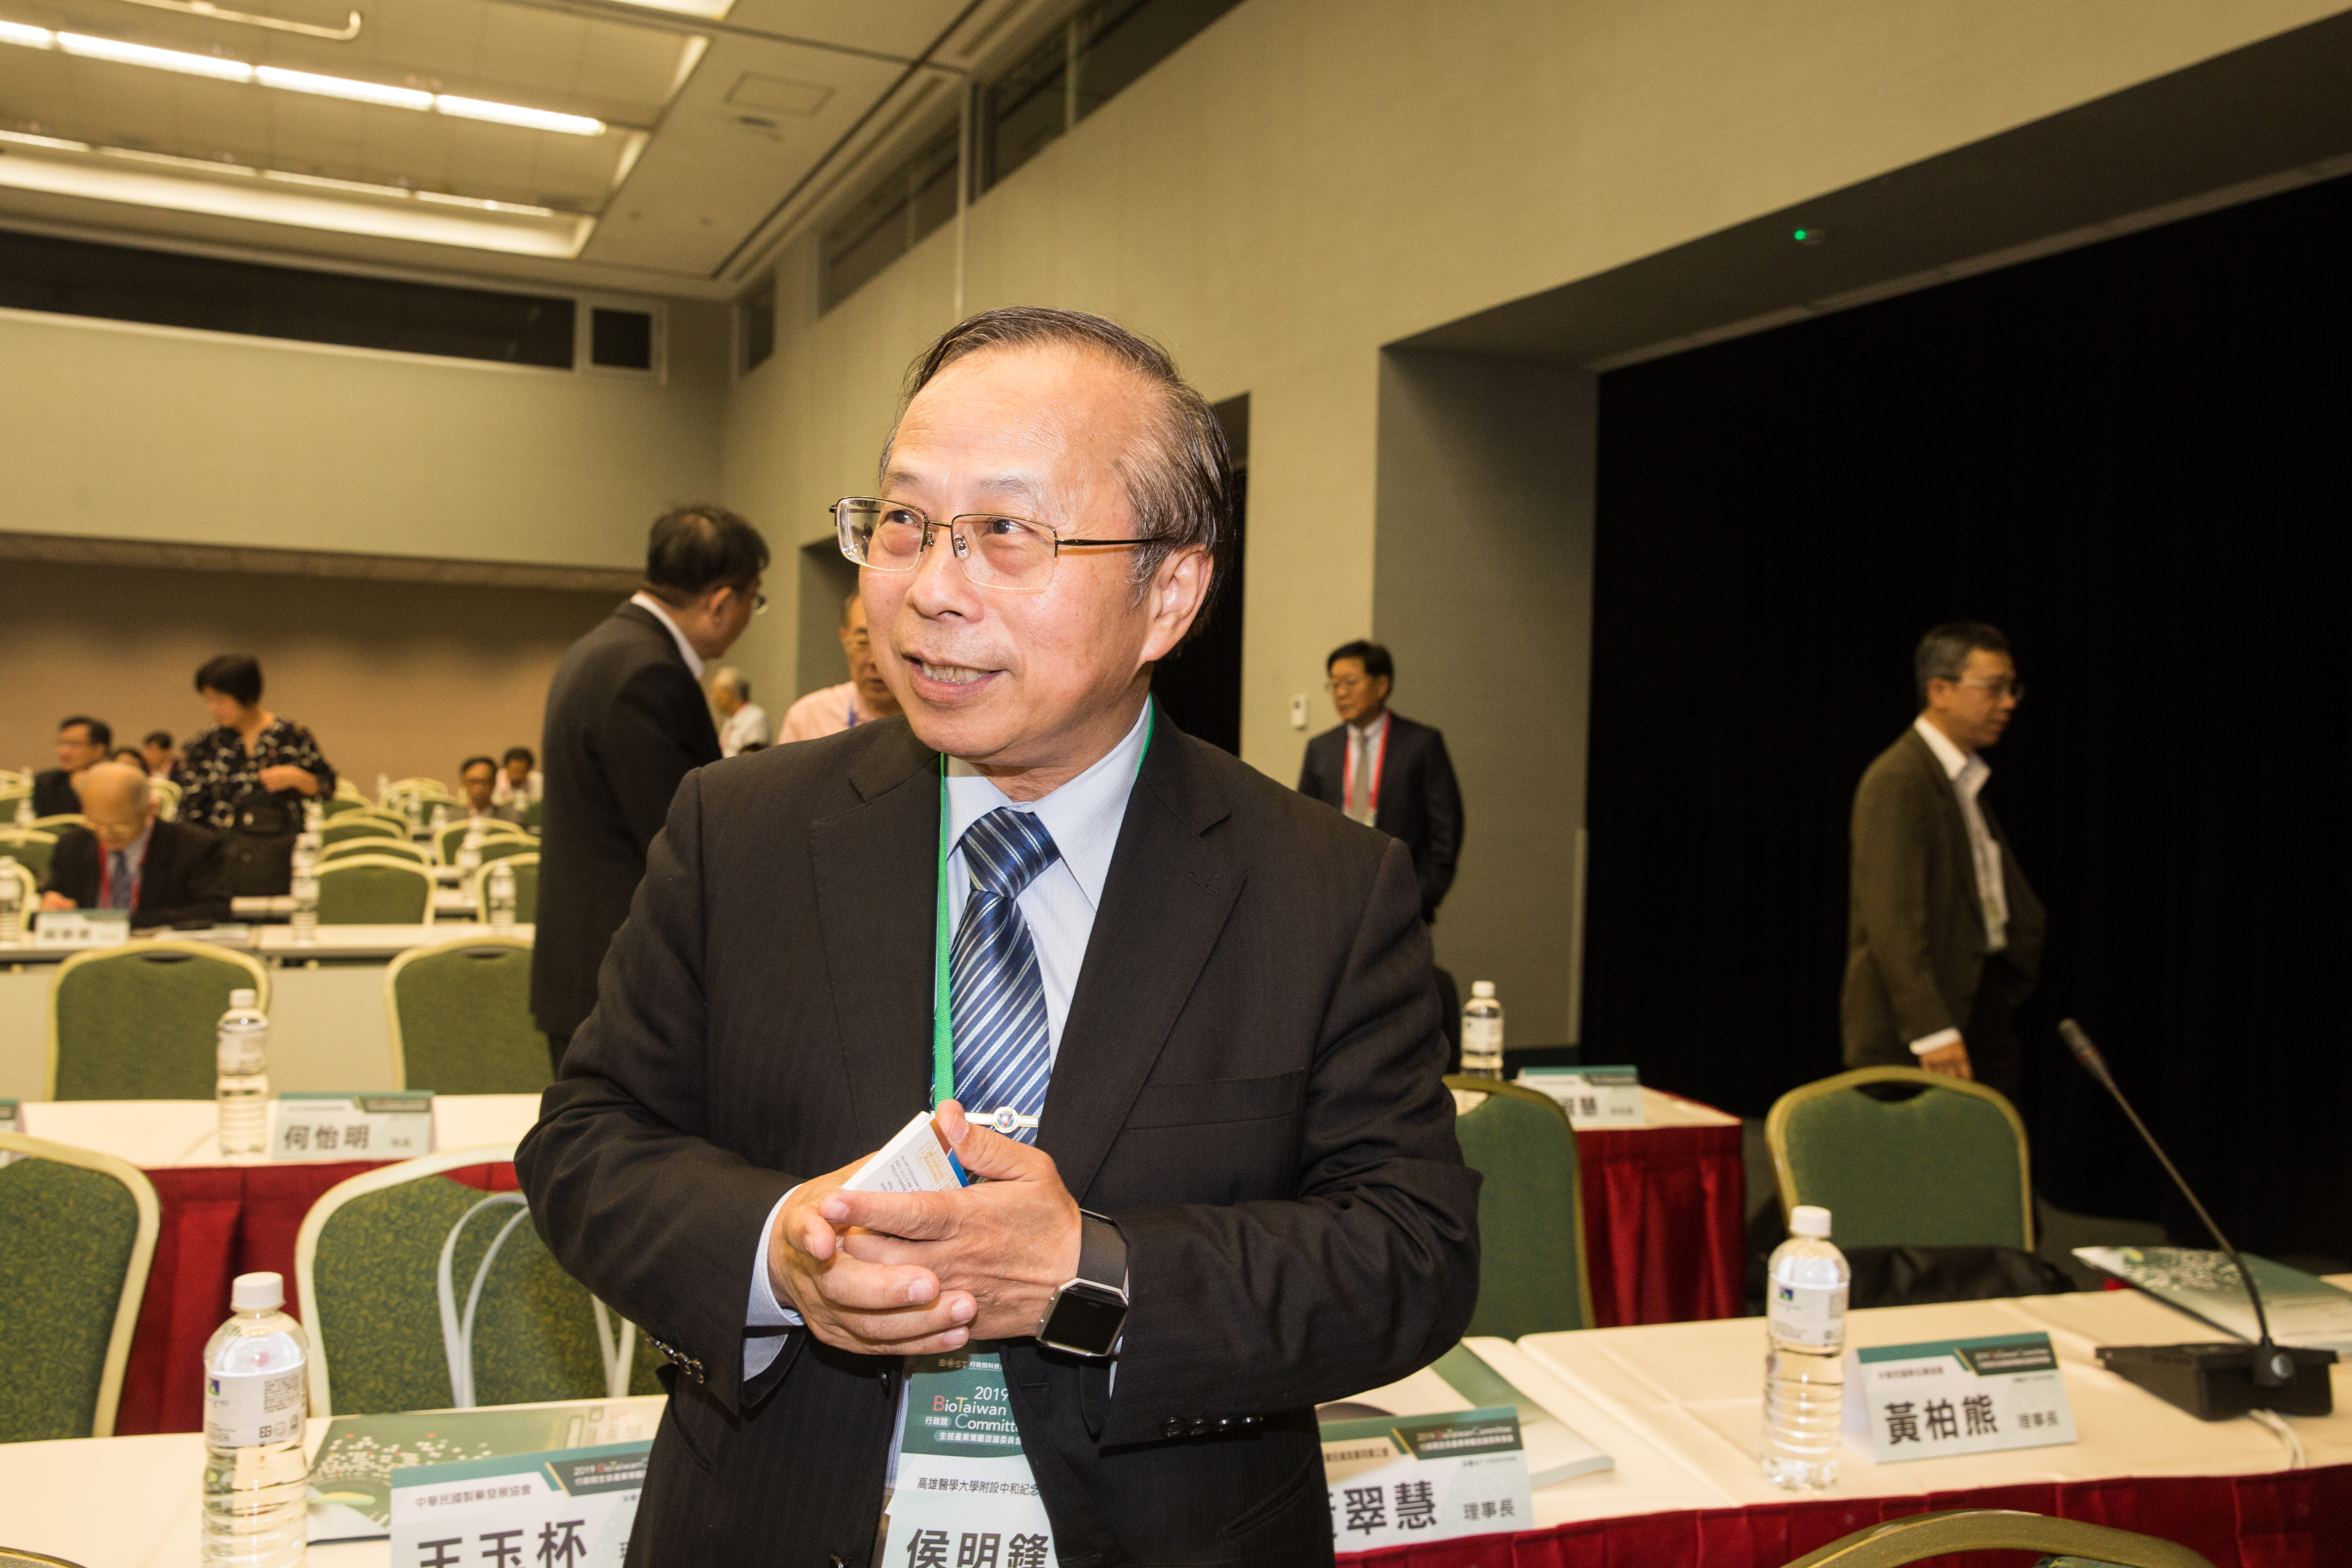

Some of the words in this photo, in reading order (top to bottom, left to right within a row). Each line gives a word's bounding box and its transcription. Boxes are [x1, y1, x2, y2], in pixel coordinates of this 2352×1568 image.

[898, 1178, 907, 1192] Republic
[970, 1361, 1003, 1370] 行政院科技
[974, 1386, 1009, 1402] 2019
[933, 1395, 1007, 1416] BioTaiwan
[925, 1416, 948, 1426] 行政院
[955, 1413, 1019, 1433] Committ
[1884, 1394, 1998, 1445] 黃柏熊
[1328, 1480, 1437, 1539] 翠慧
[1463, 1498, 1515, 1521] 理事長
